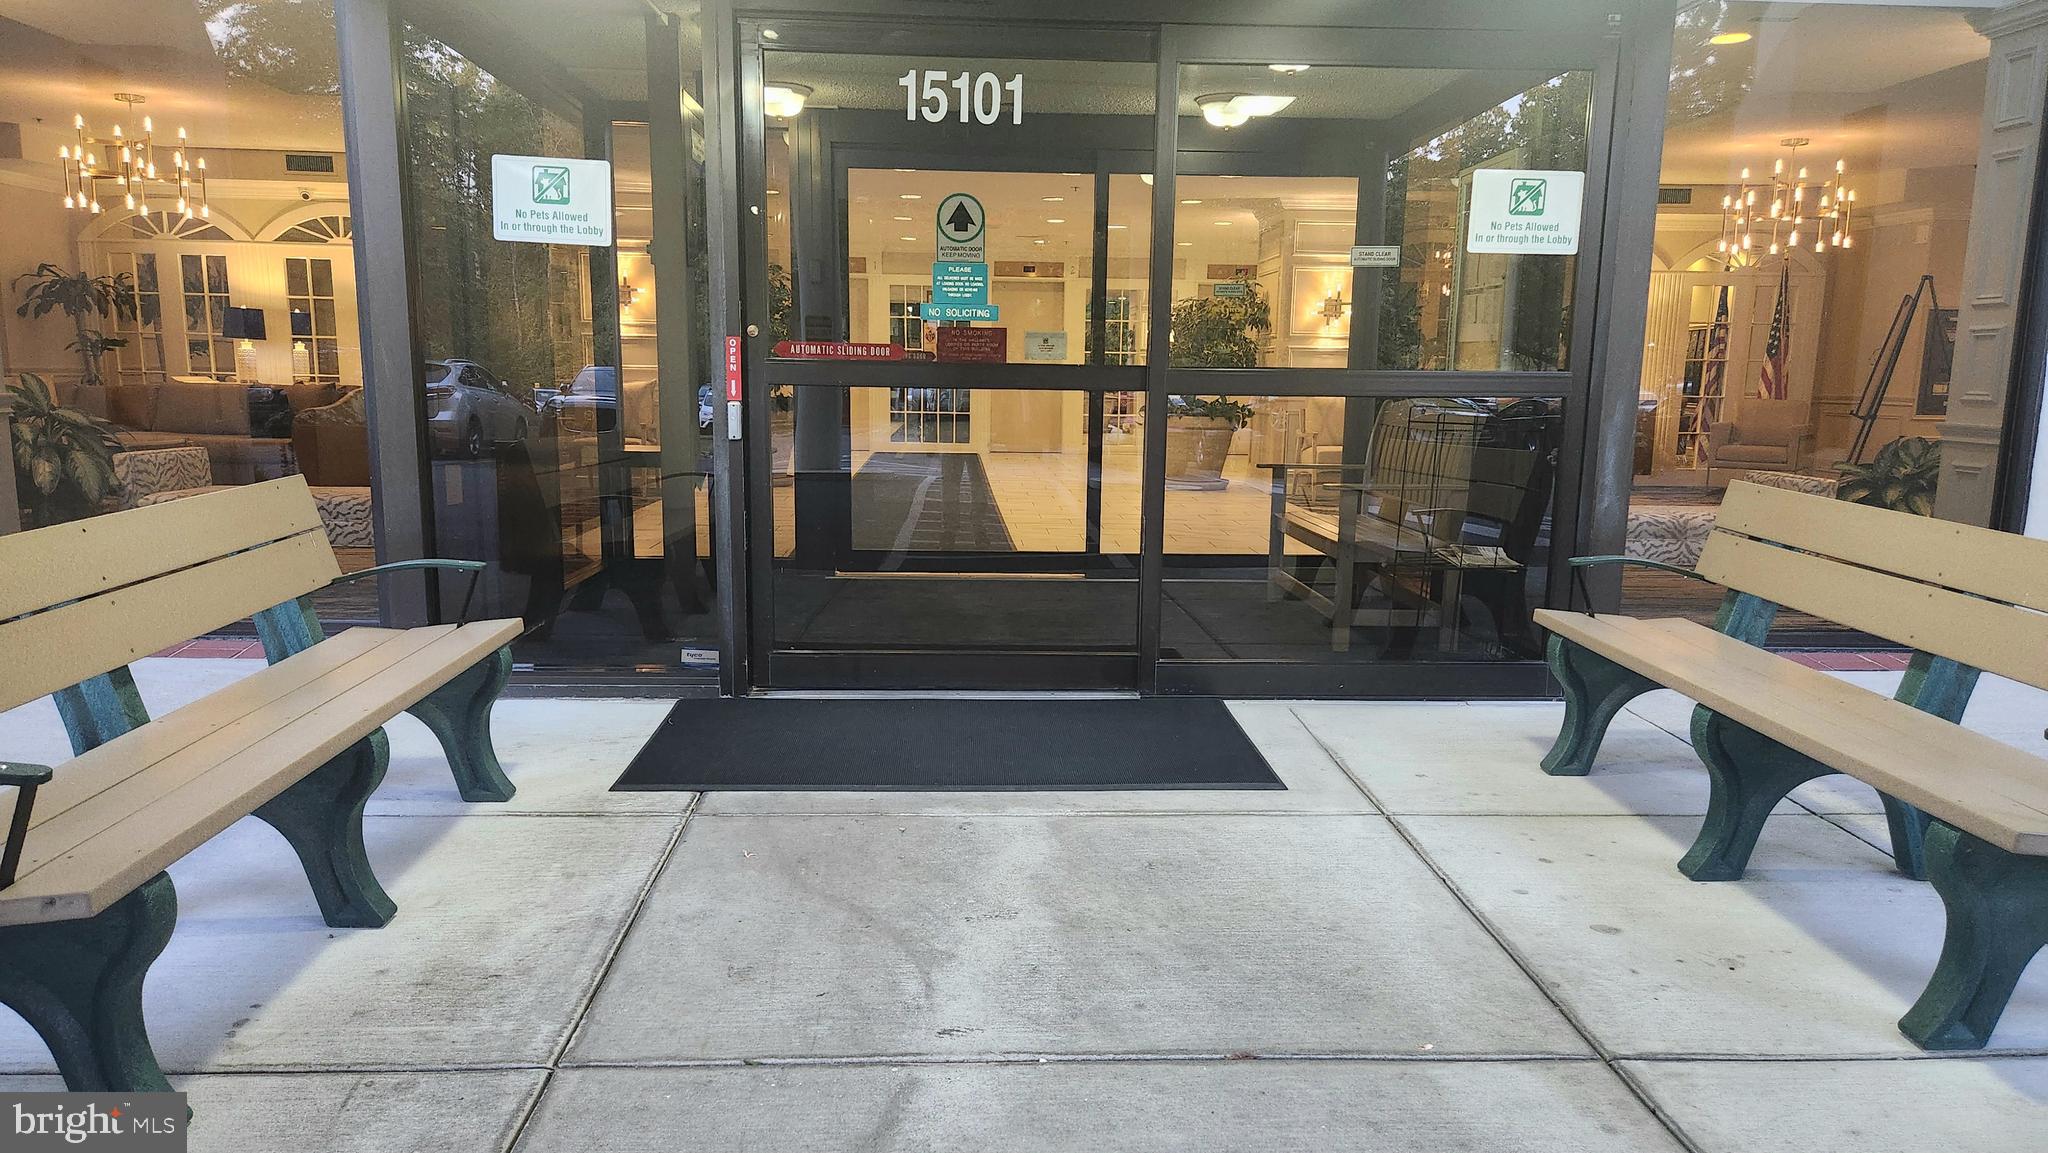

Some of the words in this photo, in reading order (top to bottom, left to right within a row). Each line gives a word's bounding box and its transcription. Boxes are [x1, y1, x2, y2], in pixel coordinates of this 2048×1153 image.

[899, 69, 1023, 125] 15101
[515, 208, 528, 219] No
[530, 209, 550, 221] Pets
[552, 211, 589, 222] Allowed
[500, 221, 509, 231] In
[511, 223, 522, 231] or
[523, 222, 558, 235] through
[560, 224, 574, 234] the
[577, 225, 604, 237] Lobby
[1490, 221, 1502, 231] No
[1504, 221, 1523, 231] Pets
[1525, 222, 1560, 232] Allowed
[1475, 233, 1484, 243] In
[1485, 235, 1495, 243] or
[1496, 234, 1529, 246] through
[1531, 234, 1545, 244] the
[1547, 235, 1573, 246] Lobby
[928, 308, 941, 316] NO
[945, 308, 990, 318] SOLICITING
[729, 338, 737, 372] OPEN
[790, 344, 834, 355] AUTOMATIC
[837, 345, 867, 356] SLIDING
[870, 346, 891, 357] DOOR
